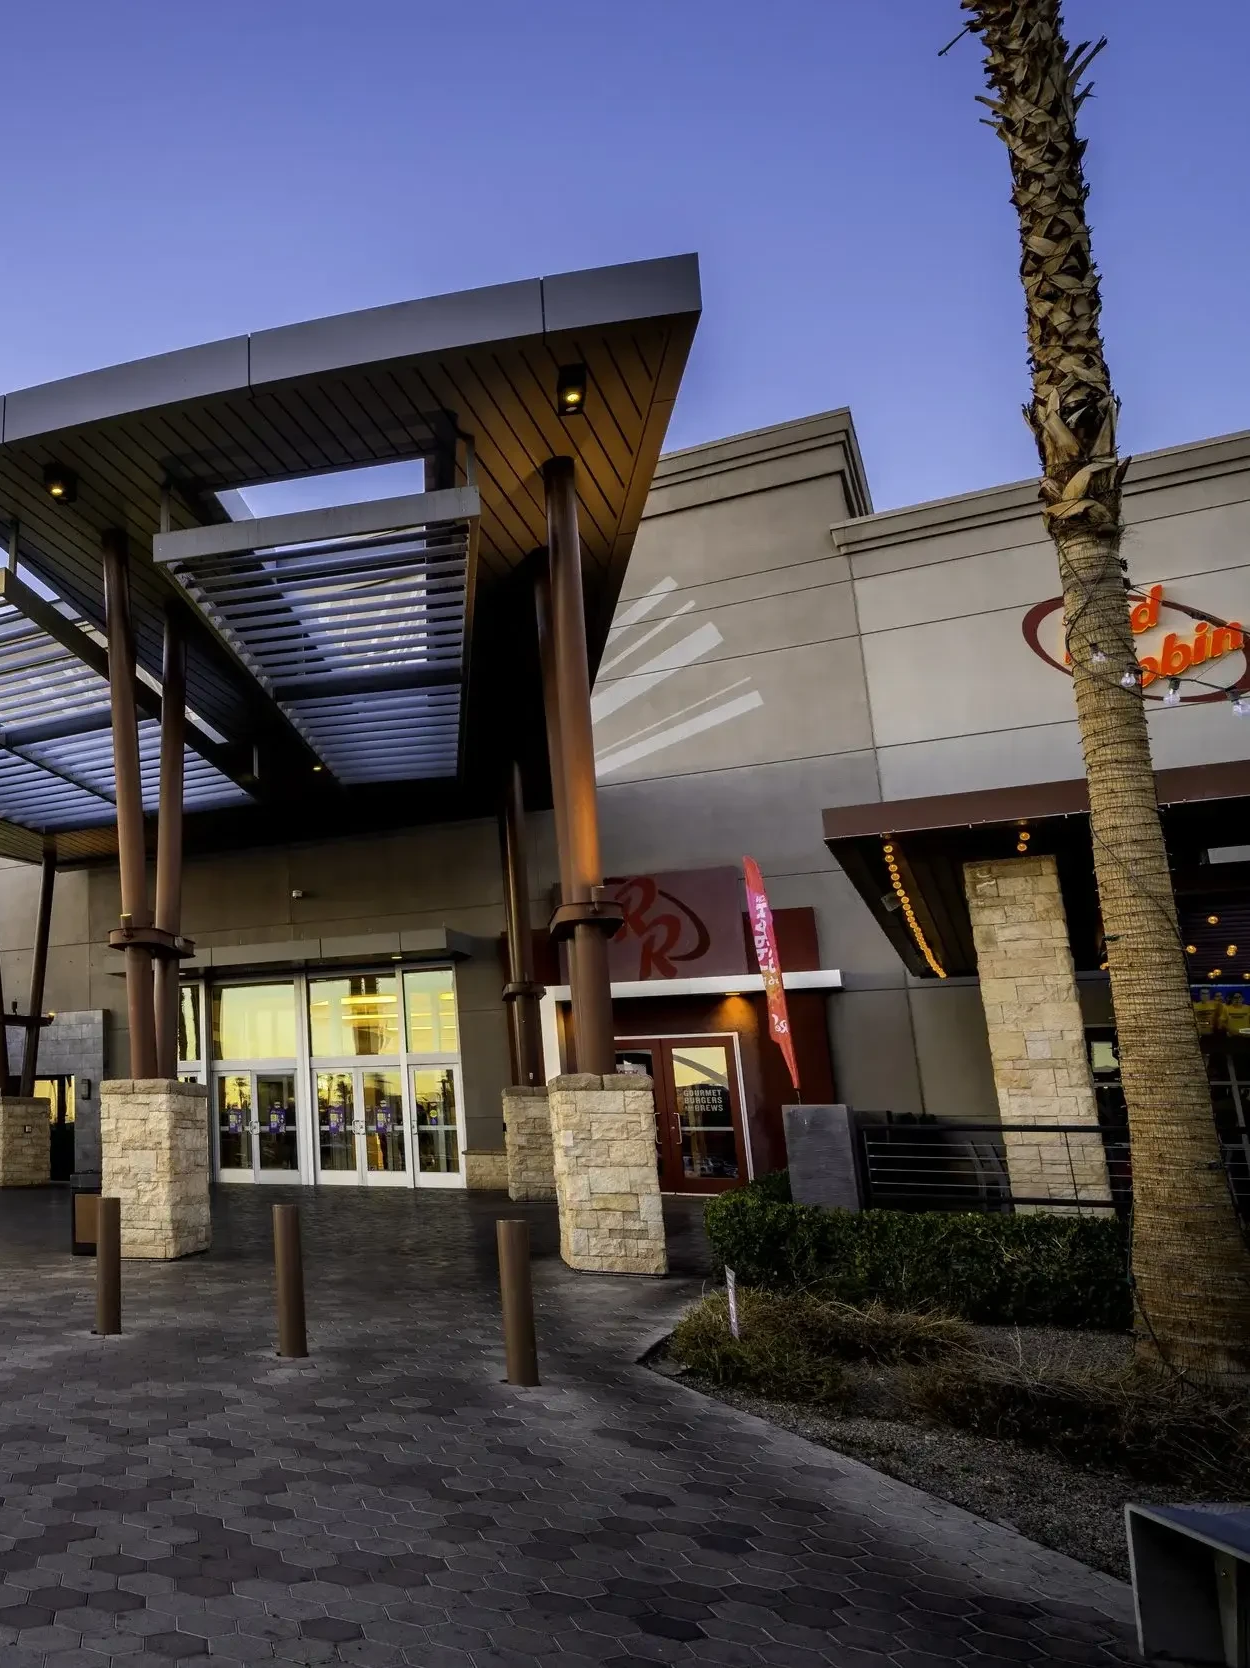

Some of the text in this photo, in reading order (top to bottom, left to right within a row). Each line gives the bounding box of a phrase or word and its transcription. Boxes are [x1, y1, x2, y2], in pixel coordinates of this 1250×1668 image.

[1136, 621, 1244, 688] obin
[683, 1089, 722, 1097] GOURMET
[684, 1096, 723, 1104] BURGERS
[694, 1104, 724, 1112] BREWS
